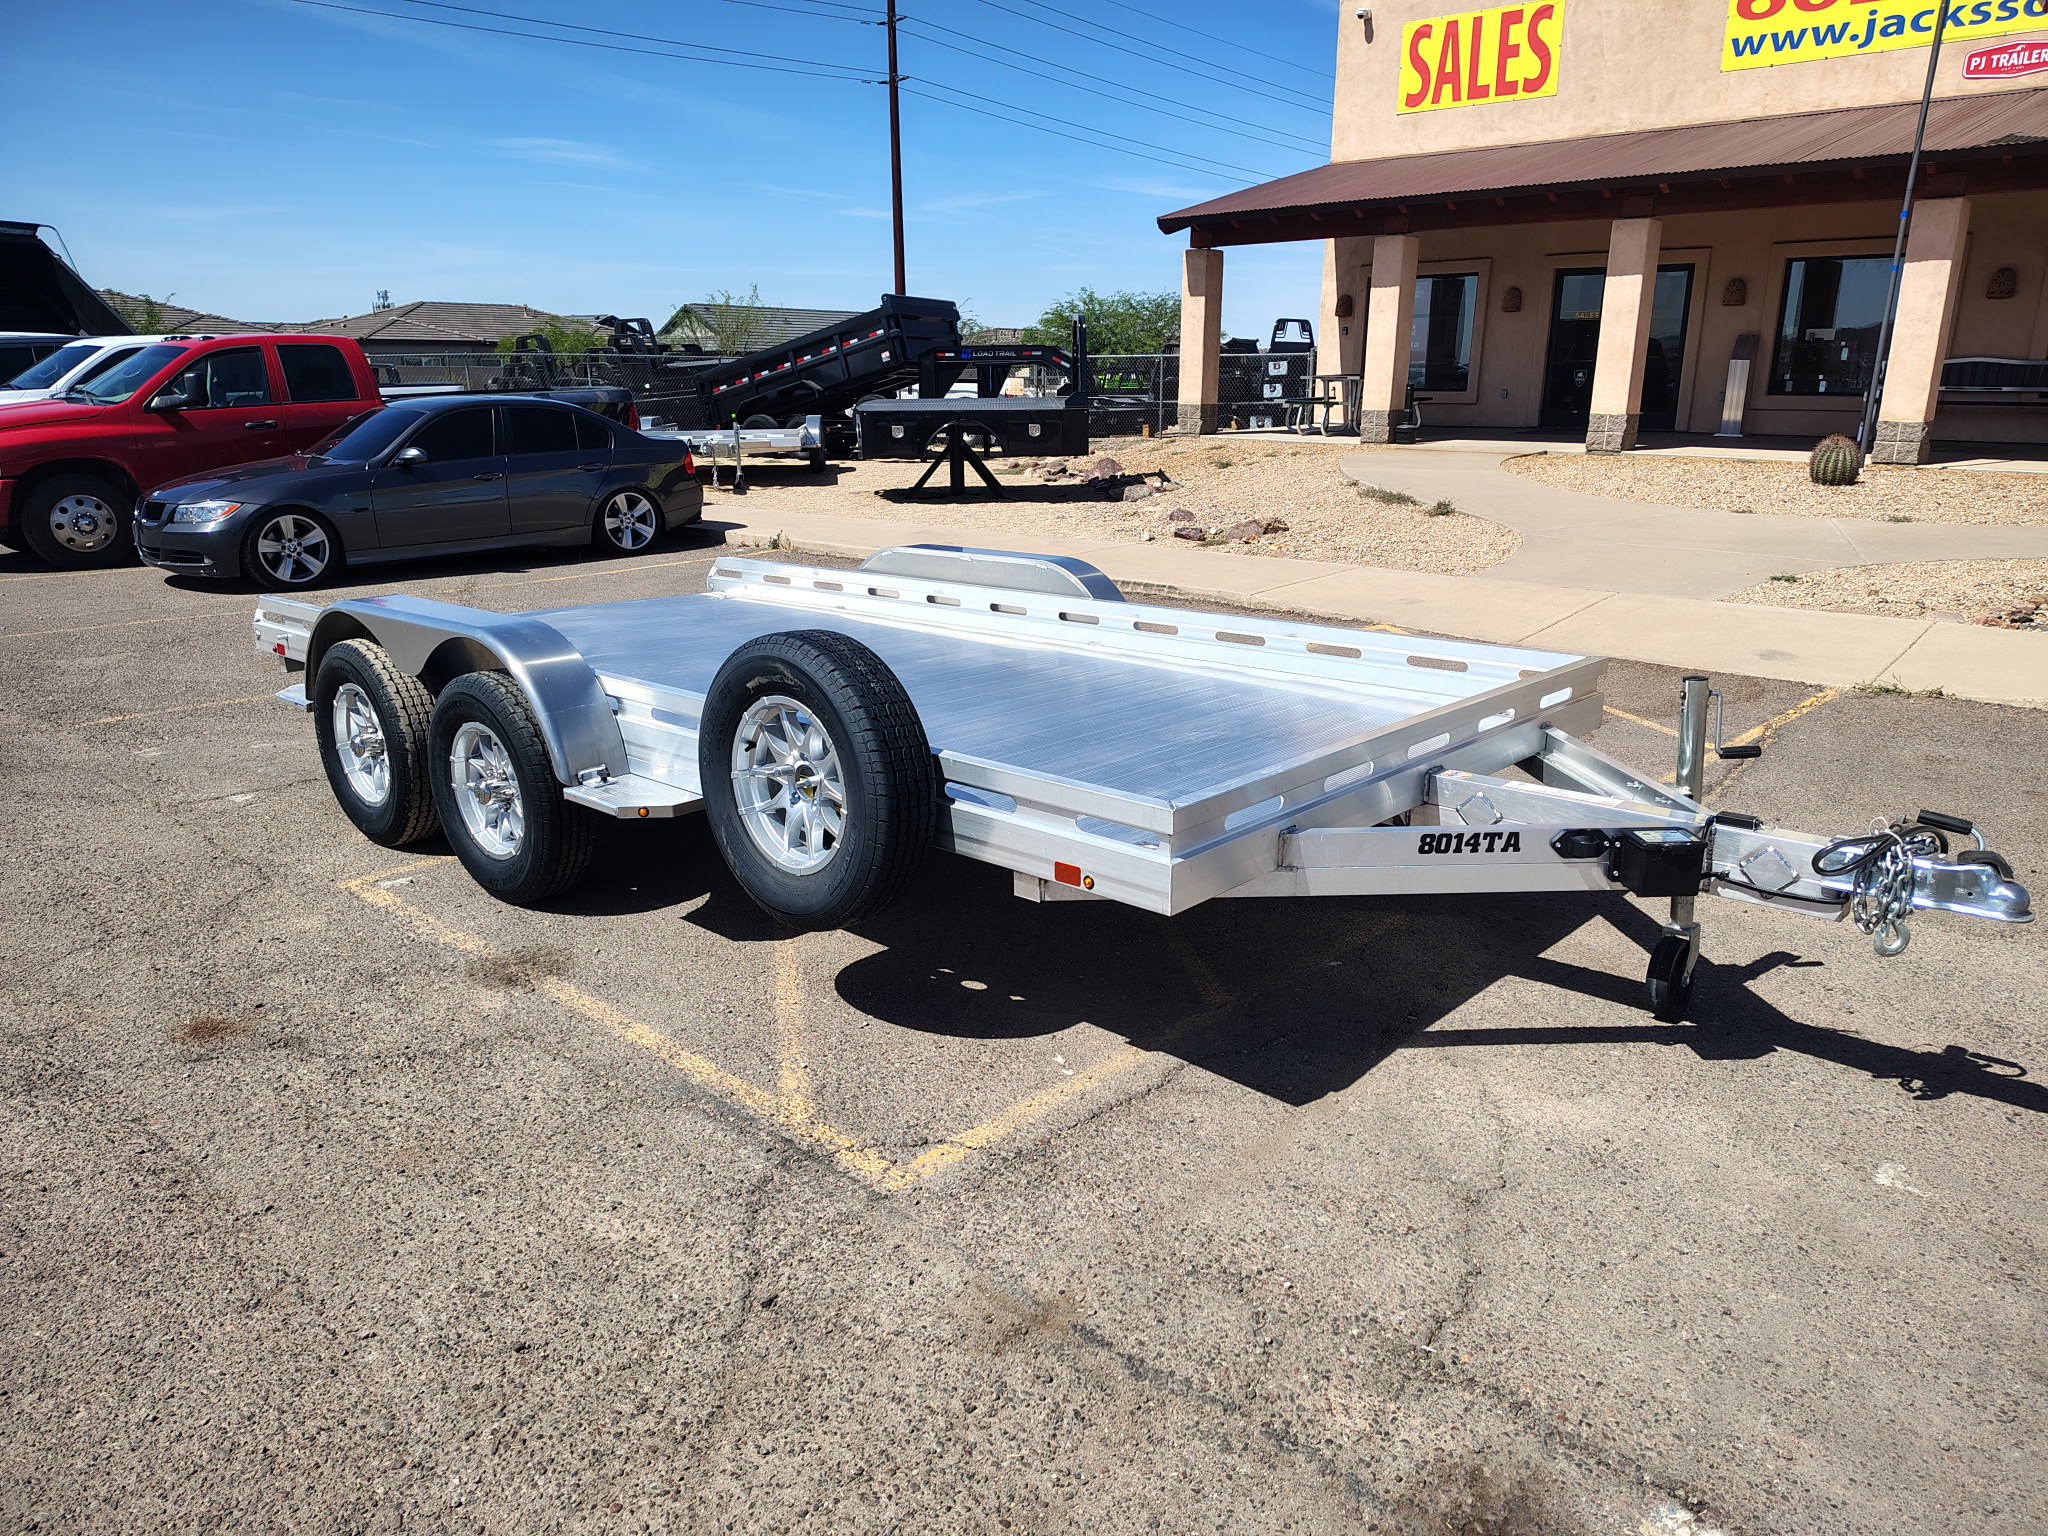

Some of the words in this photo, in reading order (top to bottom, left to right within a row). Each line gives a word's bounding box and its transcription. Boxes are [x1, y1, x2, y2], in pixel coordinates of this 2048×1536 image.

[1405, 4, 1554, 107] SALES
[1969, 56, 1986, 71] PJ
[1418, 831, 1521, 854] 8014TA
